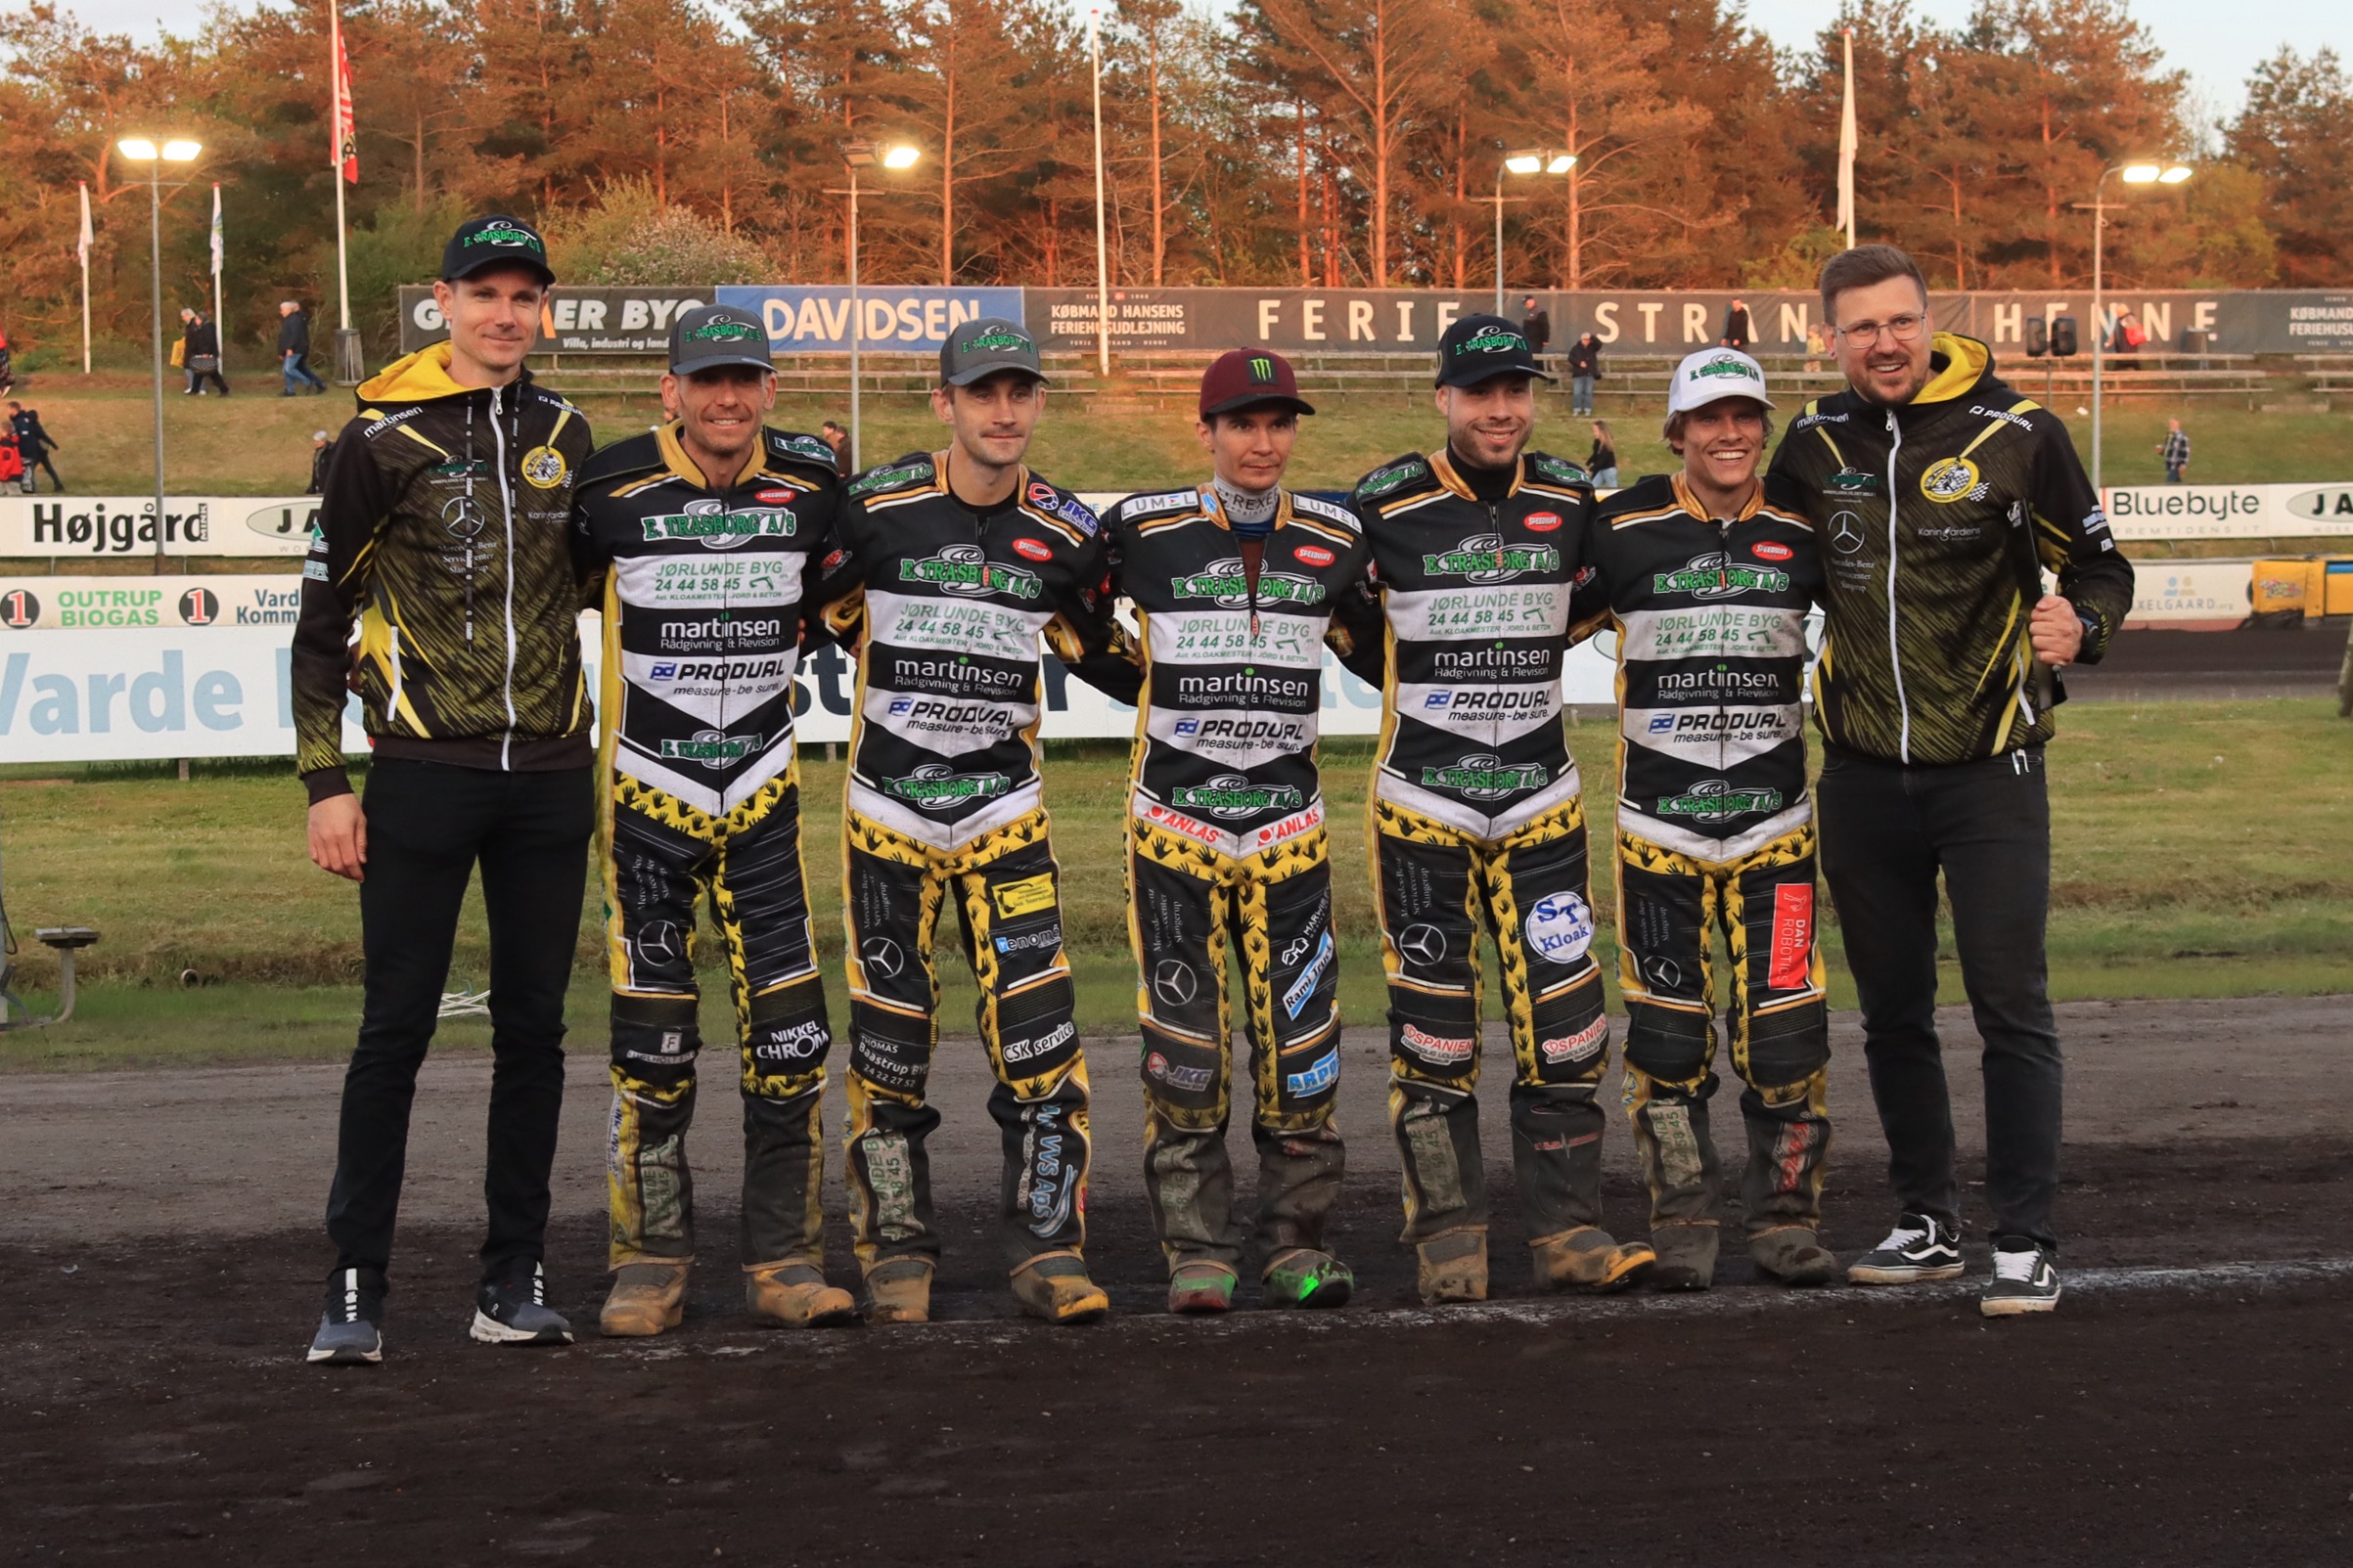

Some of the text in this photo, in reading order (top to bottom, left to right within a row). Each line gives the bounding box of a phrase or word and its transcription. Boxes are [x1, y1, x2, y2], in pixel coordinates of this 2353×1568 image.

[763, 297, 979, 341] DAVIDSEN
[1051, 305, 1184, 318] KØBMAD HANSENS
[1259, 299, 1462, 342] FERIE
[563, 337, 669, 349] Villa, industri og land
[364, 406, 424, 438] martinsen
[1796, 412, 1849, 429] martinsen
[1984, 409, 2033, 432] PRODUAL
[1062, 500, 1097, 531] JKG
[2113, 490, 2260, 520] Bluebyte
[32, 502, 208, 553] Højgård
[200, 503, 208, 542] MINK
[644, 514, 795, 539] E. TRASBORG A/S
[656, 560, 783, 577] JØRLUNDE BYG
[1425, 556, 1441, 574] E.
[1534, 550, 1560, 572] A/S
[656, 577, 741, 592] 24 44 58 45
[900, 560, 1042, 599] E. TRASBRG A/S
[1654, 574, 1670, 592] E.
[1761, 572, 1788, 592] A/S
[58, 590, 162, 607] OUTRUP
[254, 588, 299, 606] Vard
[1174, 578, 1190, 598] E.
[1296, 583, 1325, 605] A/S
[1428, 593, 1554, 611] JØRLUNDE BYG
[8, 591, 31, 626] 1
[186, 588, 211, 624] 1
[237, 605, 299, 624] Komm
[61, 608, 159, 626] BIOGAS
[661, 611, 781, 639] martinsen
[900, 603, 1025, 633] JØRLUNDE BYG
[1428, 609, 1515, 626] 24 44 58 45
[1655, 612, 1781, 631] JØRLUNDE BYG
[895, 619, 985, 639] 24 44 58 45
[1278, 622, 1310, 637] BYG
[1444, 626, 1501, 635] KLOAKMESTER
[1655, 630, 1739, 647] 24 44 58 45
[660, 637, 780, 651] Rådgivning & Revision
[910, 635, 969, 648] KLOAKMESTER
[1176, 635, 1268, 650] 24 44 58 45
[1191, 650, 1252, 659] KLOAKMESTER
[1434, 642, 1550, 668] martinsen
[678, 659, 785, 681] PRODUAL
[895, 656, 1022, 688] martinsen
[1434, 666, 1549, 679] Rådgivning & Revision
[1657, 664, 1779, 688] martinsen
[895, 676, 1018, 695] Rådgivning & Revision
[1179, 666, 1309, 697] martinsen
[1179, 694, 1306, 708] Rådgivning & Revision
[1452, 690, 1550, 709] PRODUAL
[1657, 688, 1719, 700] Rådgivning
[1725, 689, 1733, 697] &
[910, 700, 1017, 726] PRODUAL
[1529, 709, 1550, 719] sure.
[1676, 712, 1787, 731] PRODUAL
[1200, 720, 1303, 740] PRODUAL
[1423, 767, 1439, 784] E.
[900, 782, 978, 798] TRASBORG
[1173, 788, 1190, 806] E.
[1275, 789, 1303, 809] A/S
[1658, 797, 1673, 813] E.
[1757, 792, 1783, 812] A/S
[1164, 810, 1219, 844] ANLAS
[1276, 809, 1320, 839] ANLAS
[1541, 925, 1590, 953] Kloak
[1794, 918, 1806, 948] DAN
[1776, 918, 1794, 982] ROBOTICS
[1286, 975, 1313, 1008] Rami
[771, 1020, 820, 1043] NIKKEL
[1003, 1022, 1075, 1062] CSK service
[1558, 1017, 1606, 1053] SPANIEN
[756, 1032, 829, 1059] CHROM
[861, 1035, 899, 1053] THOMAS
[1413, 1033, 1473, 1053] SPANIEN
[859, 1044, 909, 1076] Baastrup
[863, 1064, 876, 1074] 24
